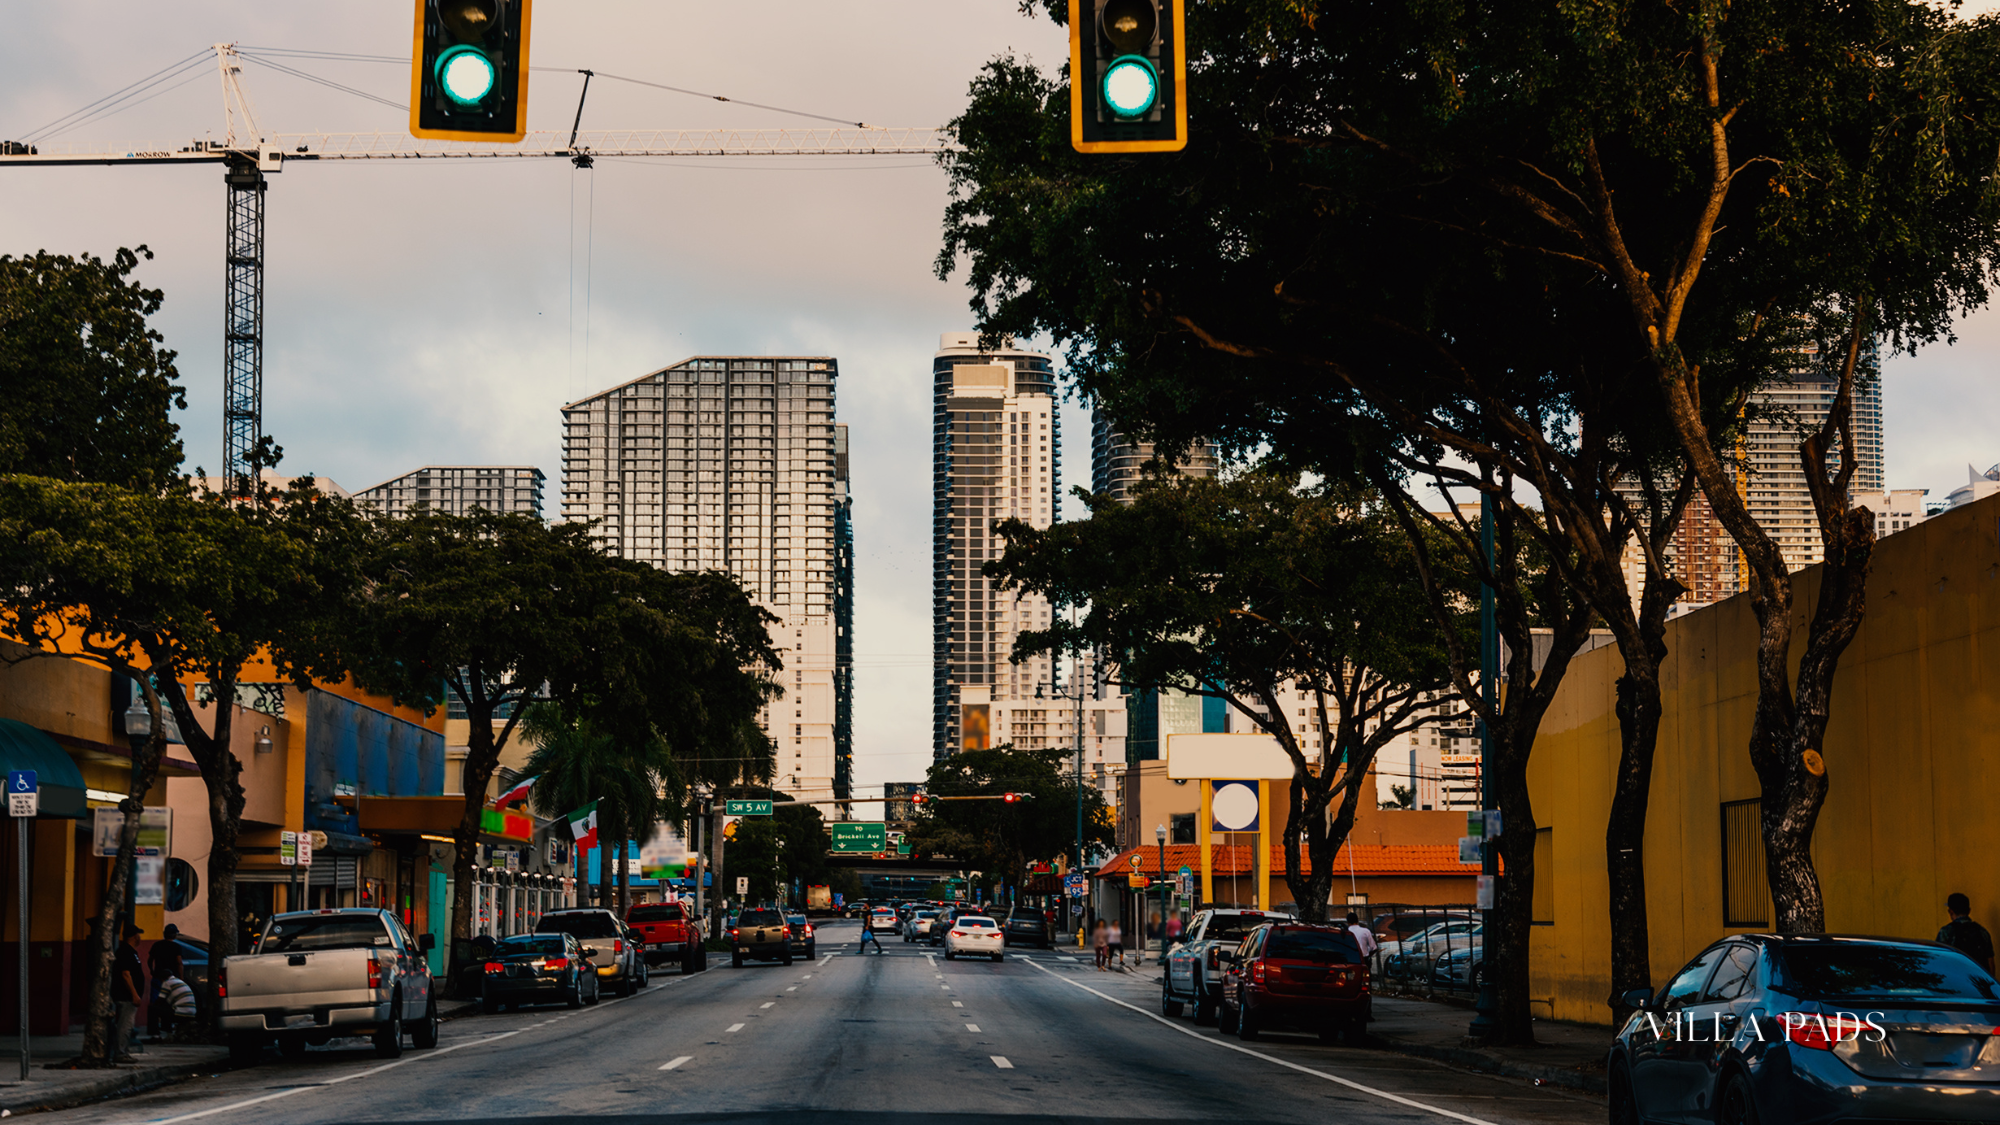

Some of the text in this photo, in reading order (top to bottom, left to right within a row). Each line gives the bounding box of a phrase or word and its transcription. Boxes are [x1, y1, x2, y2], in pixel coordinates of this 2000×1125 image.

[732, 803, 767, 812] SW 5 AV
[1072, 888, 1082, 897] 95
